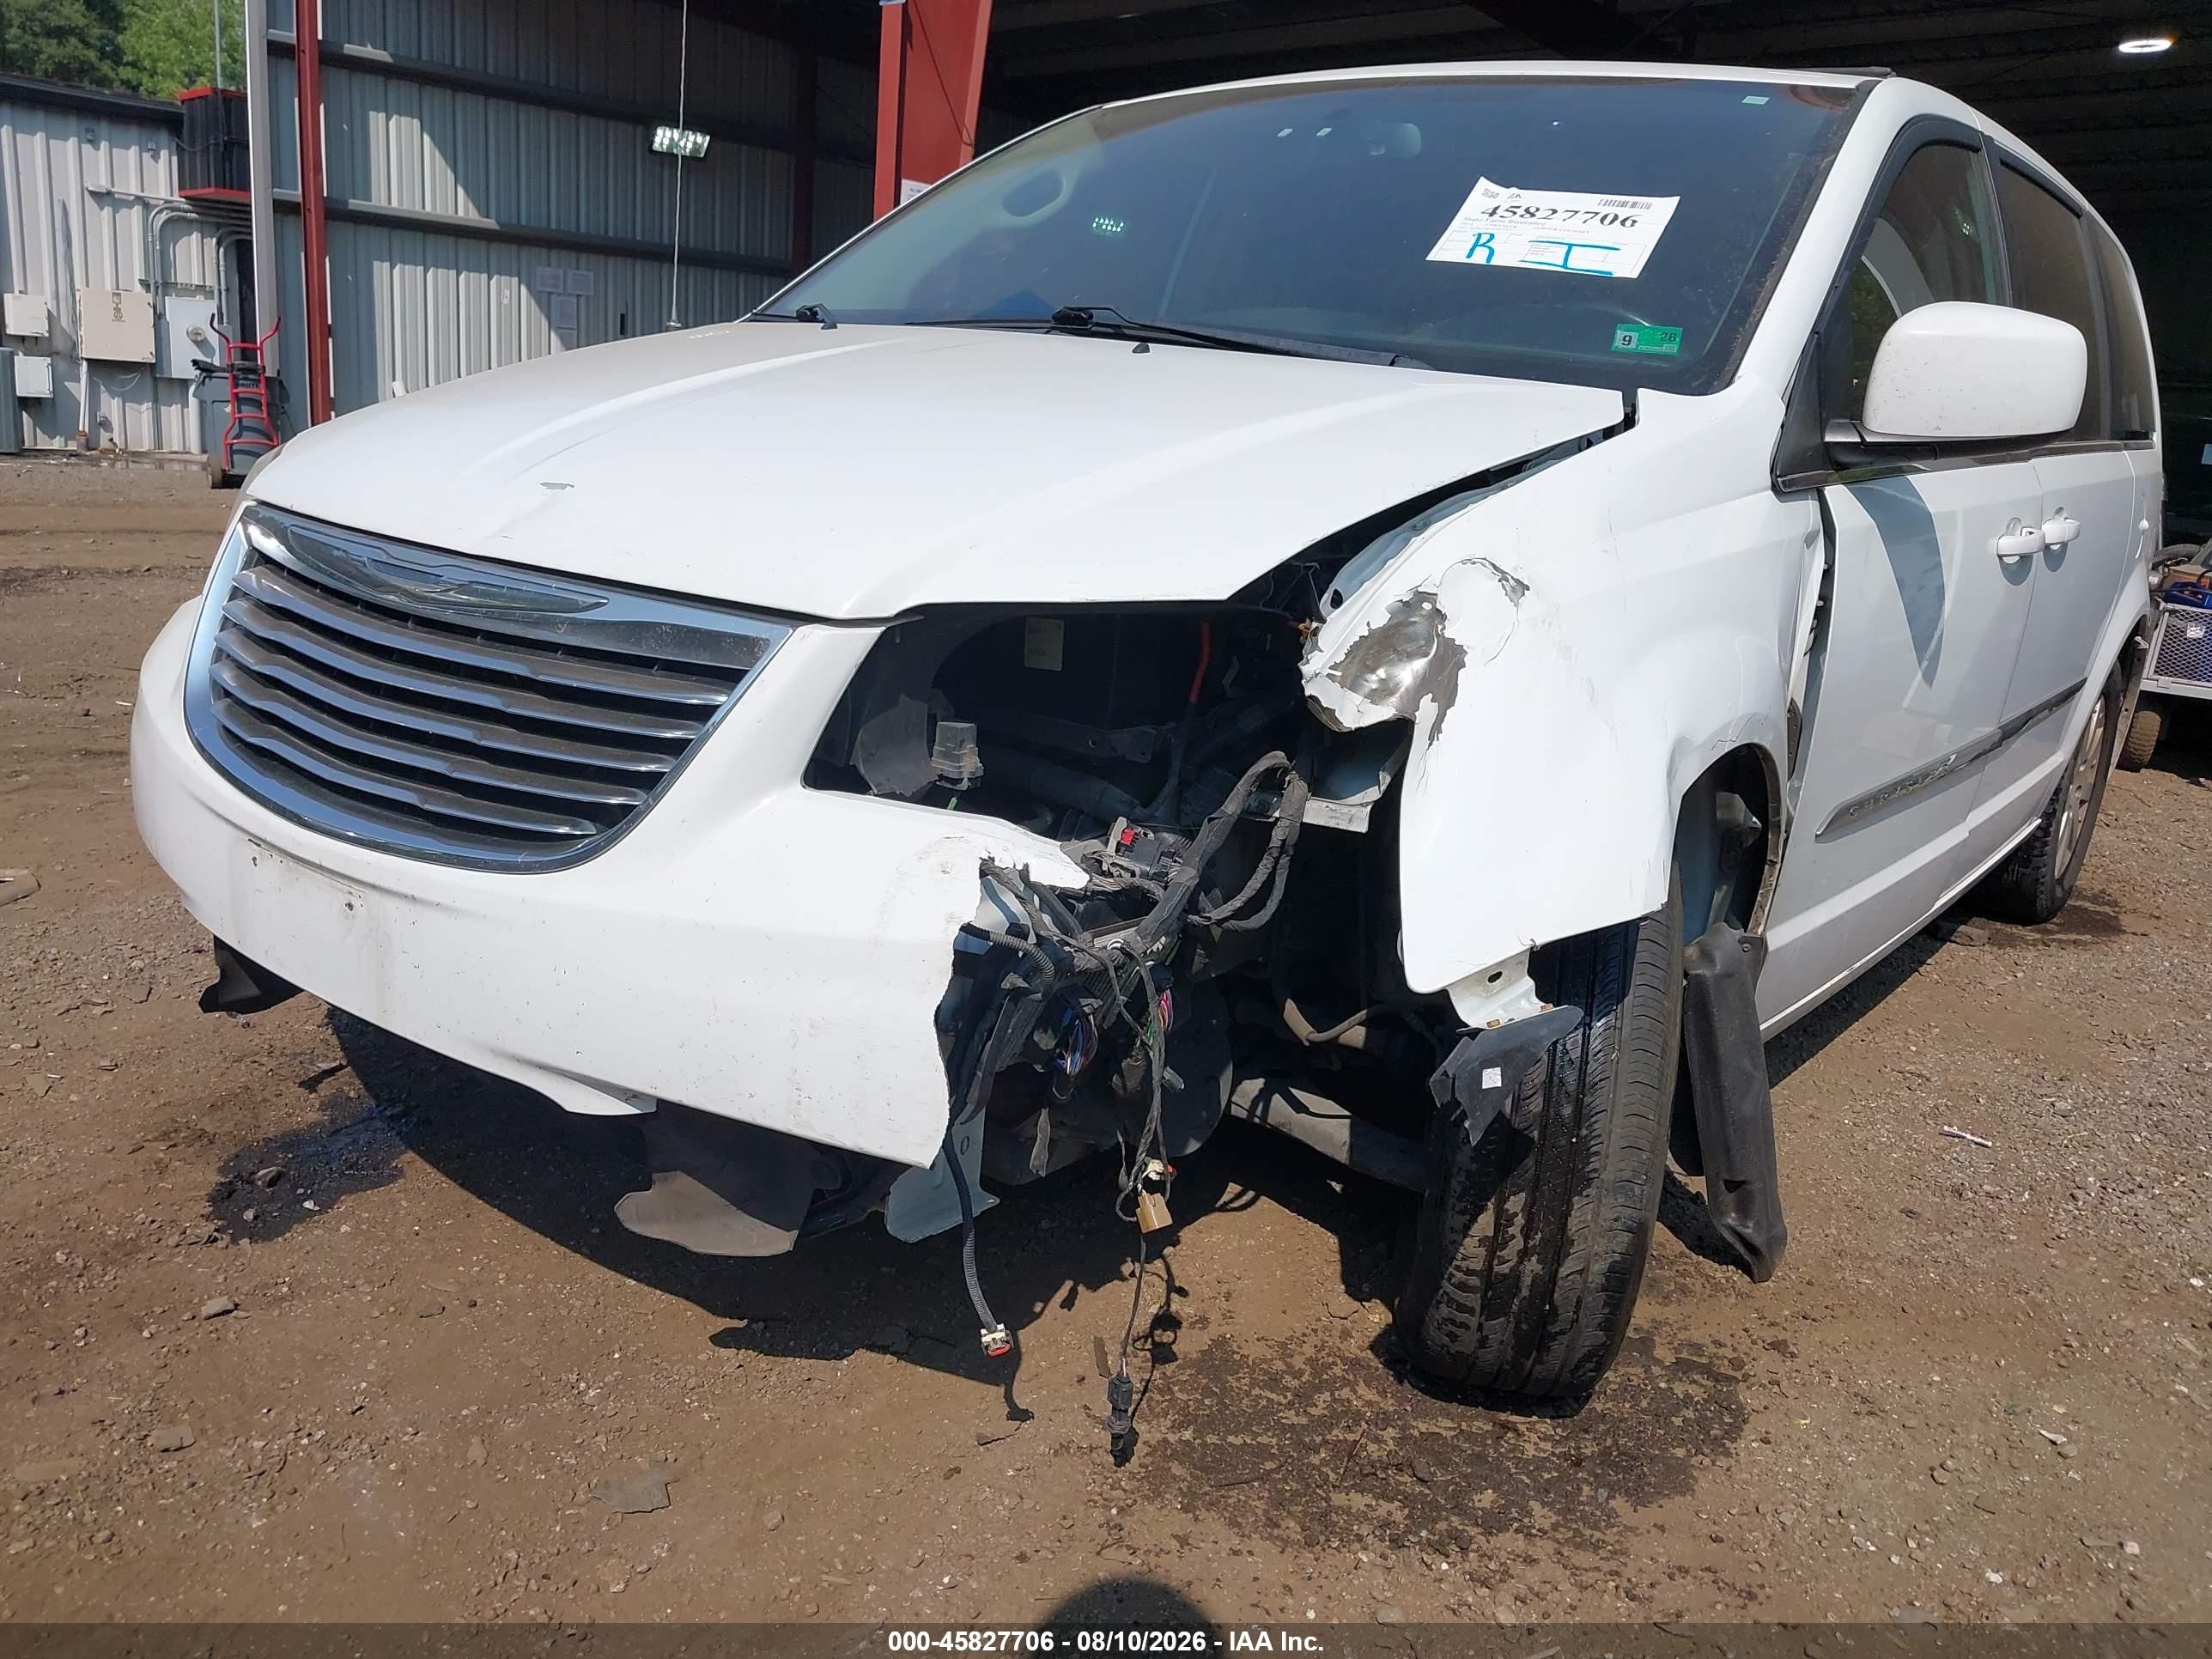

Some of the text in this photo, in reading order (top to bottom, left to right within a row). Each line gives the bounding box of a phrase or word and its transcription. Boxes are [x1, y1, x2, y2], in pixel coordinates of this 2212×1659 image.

[1480, 204, 1641, 228] 45827706
[1466, 232, 1495, 264] R
[1621, 331, 1677, 346] 9 26
